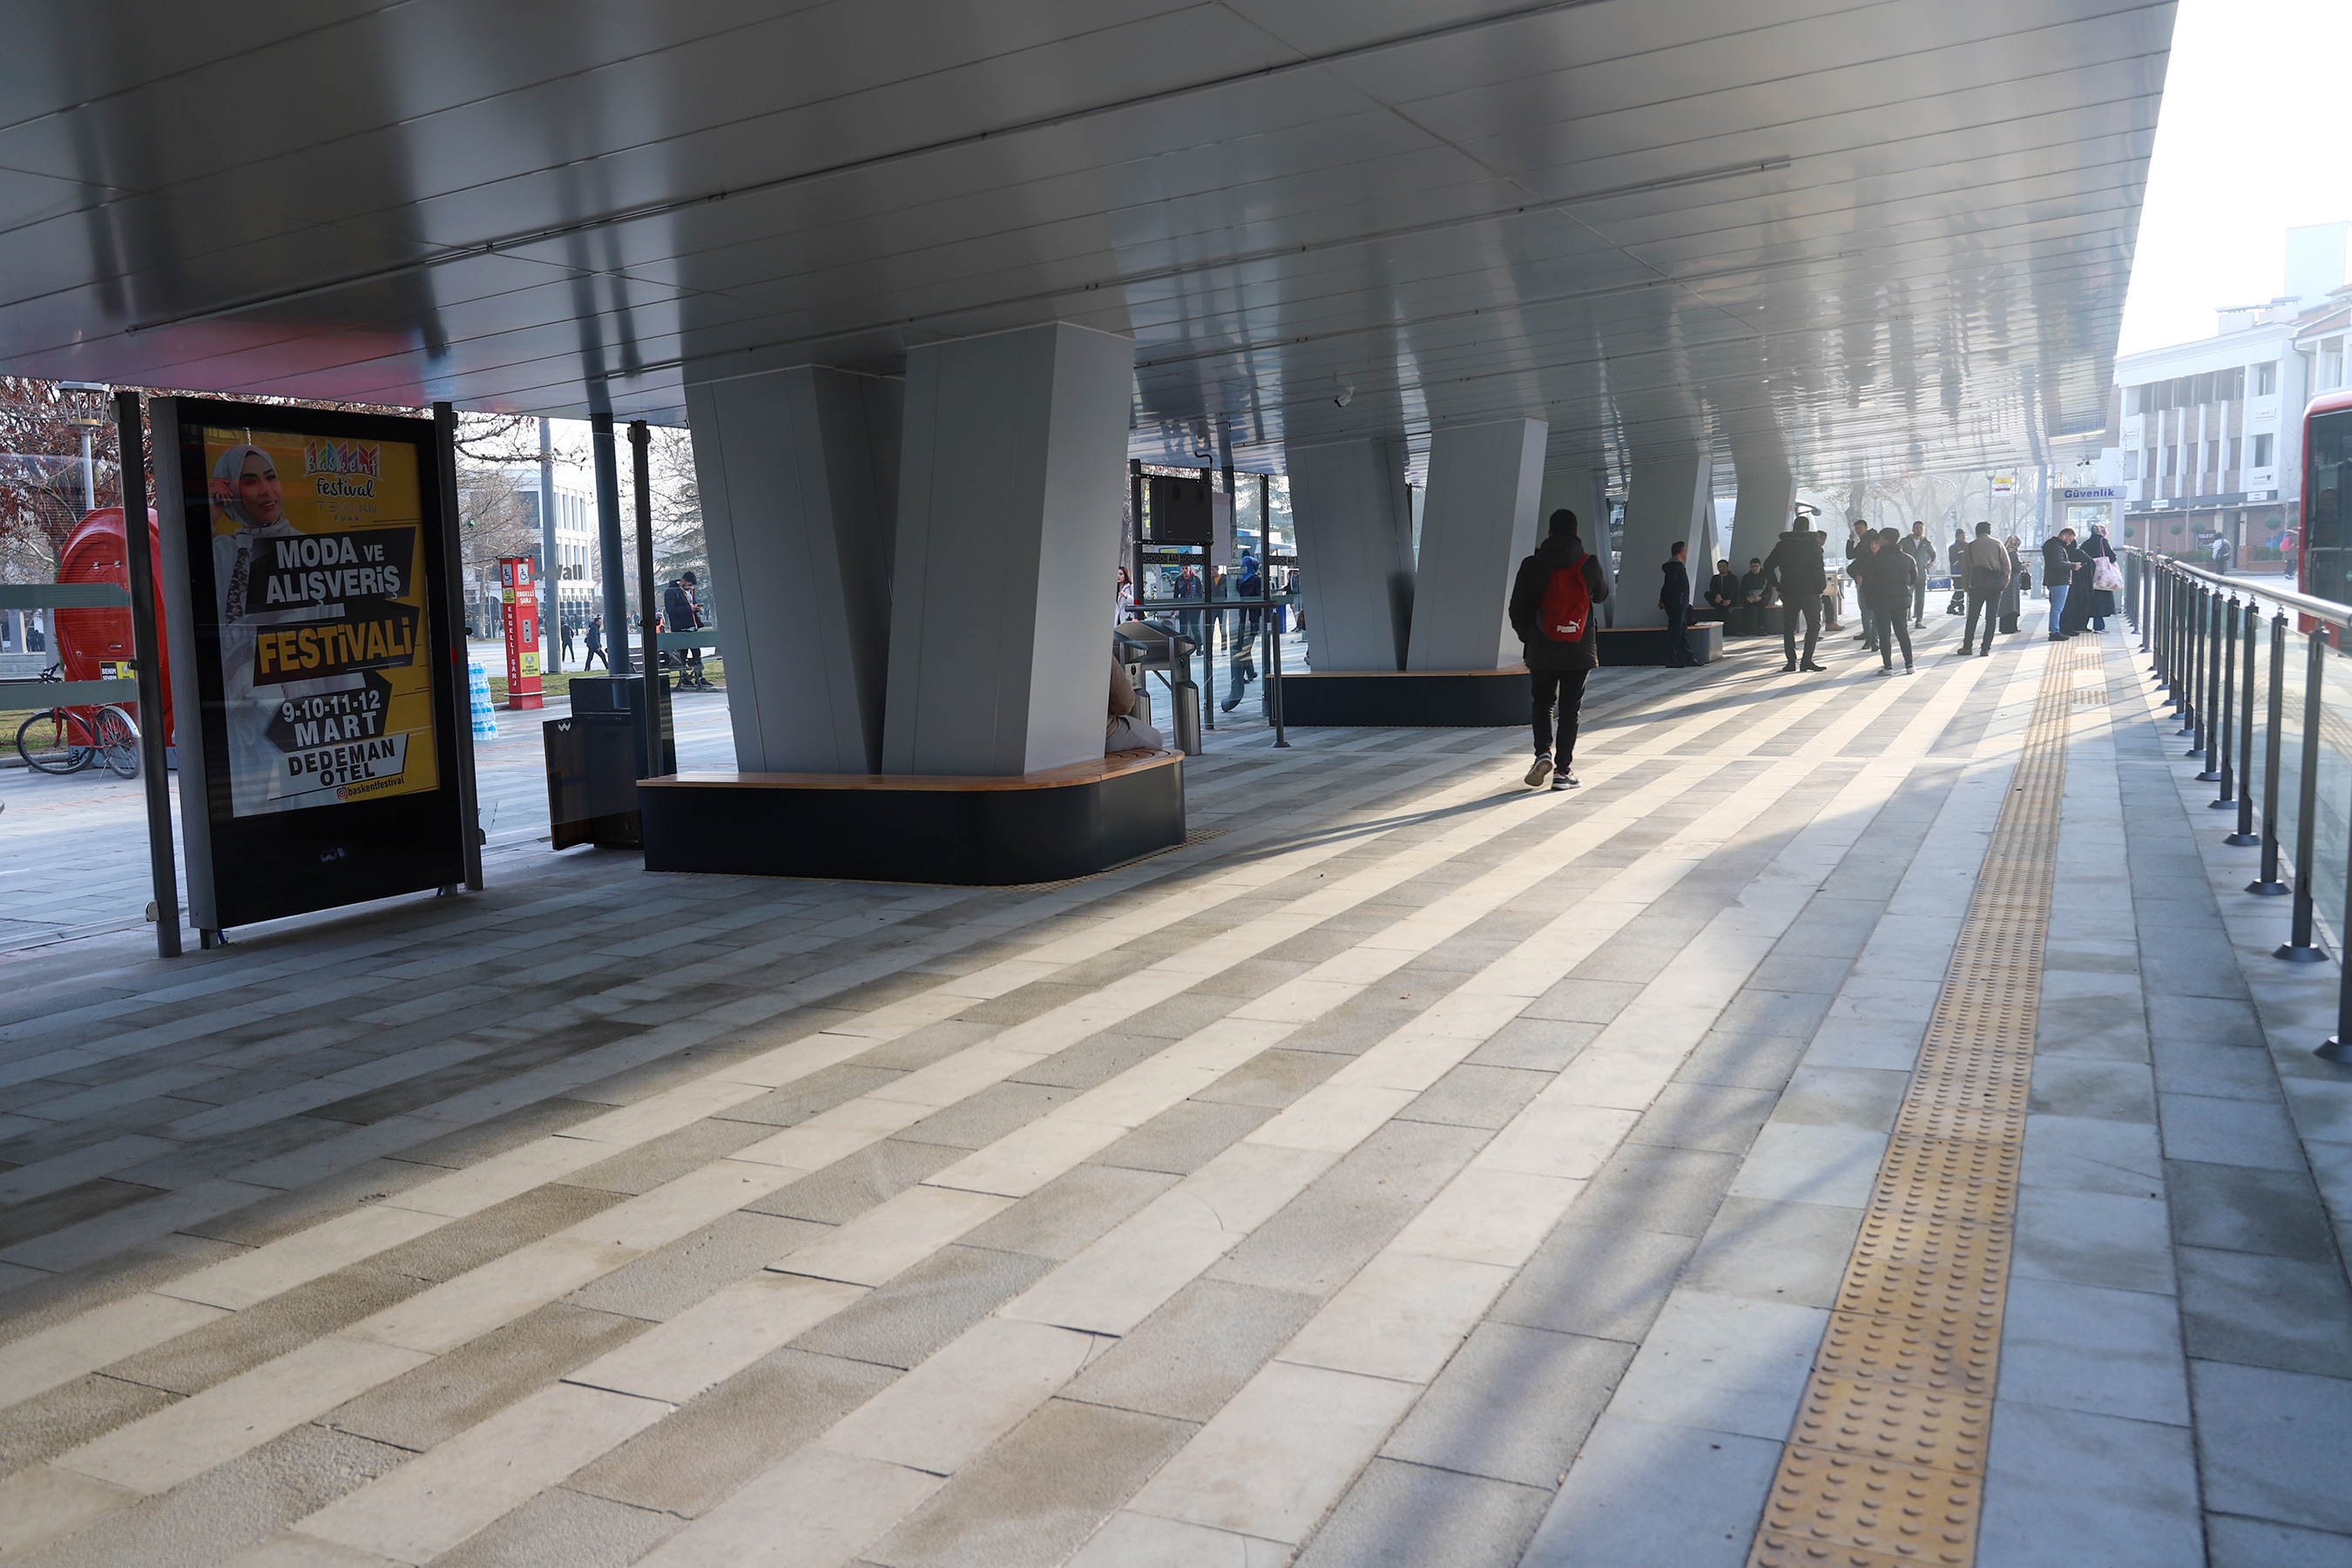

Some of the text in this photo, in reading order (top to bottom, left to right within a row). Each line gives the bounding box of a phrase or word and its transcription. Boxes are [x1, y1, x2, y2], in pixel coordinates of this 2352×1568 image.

[315, 476, 375, 497] festival
[2065, 488, 2114, 498] Güvenlik
[276, 537, 384, 569] MODA VE
[1557, 625, 1577, 633] PUMA
[281, 689, 382, 723] 9-10-11-12
[294, 711, 377, 747] MART
[287, 738, 395, 776] DEDEMAN
[320, 762, 375, 787] OTEL
[348, 774, 405, 796] baskentfestival
